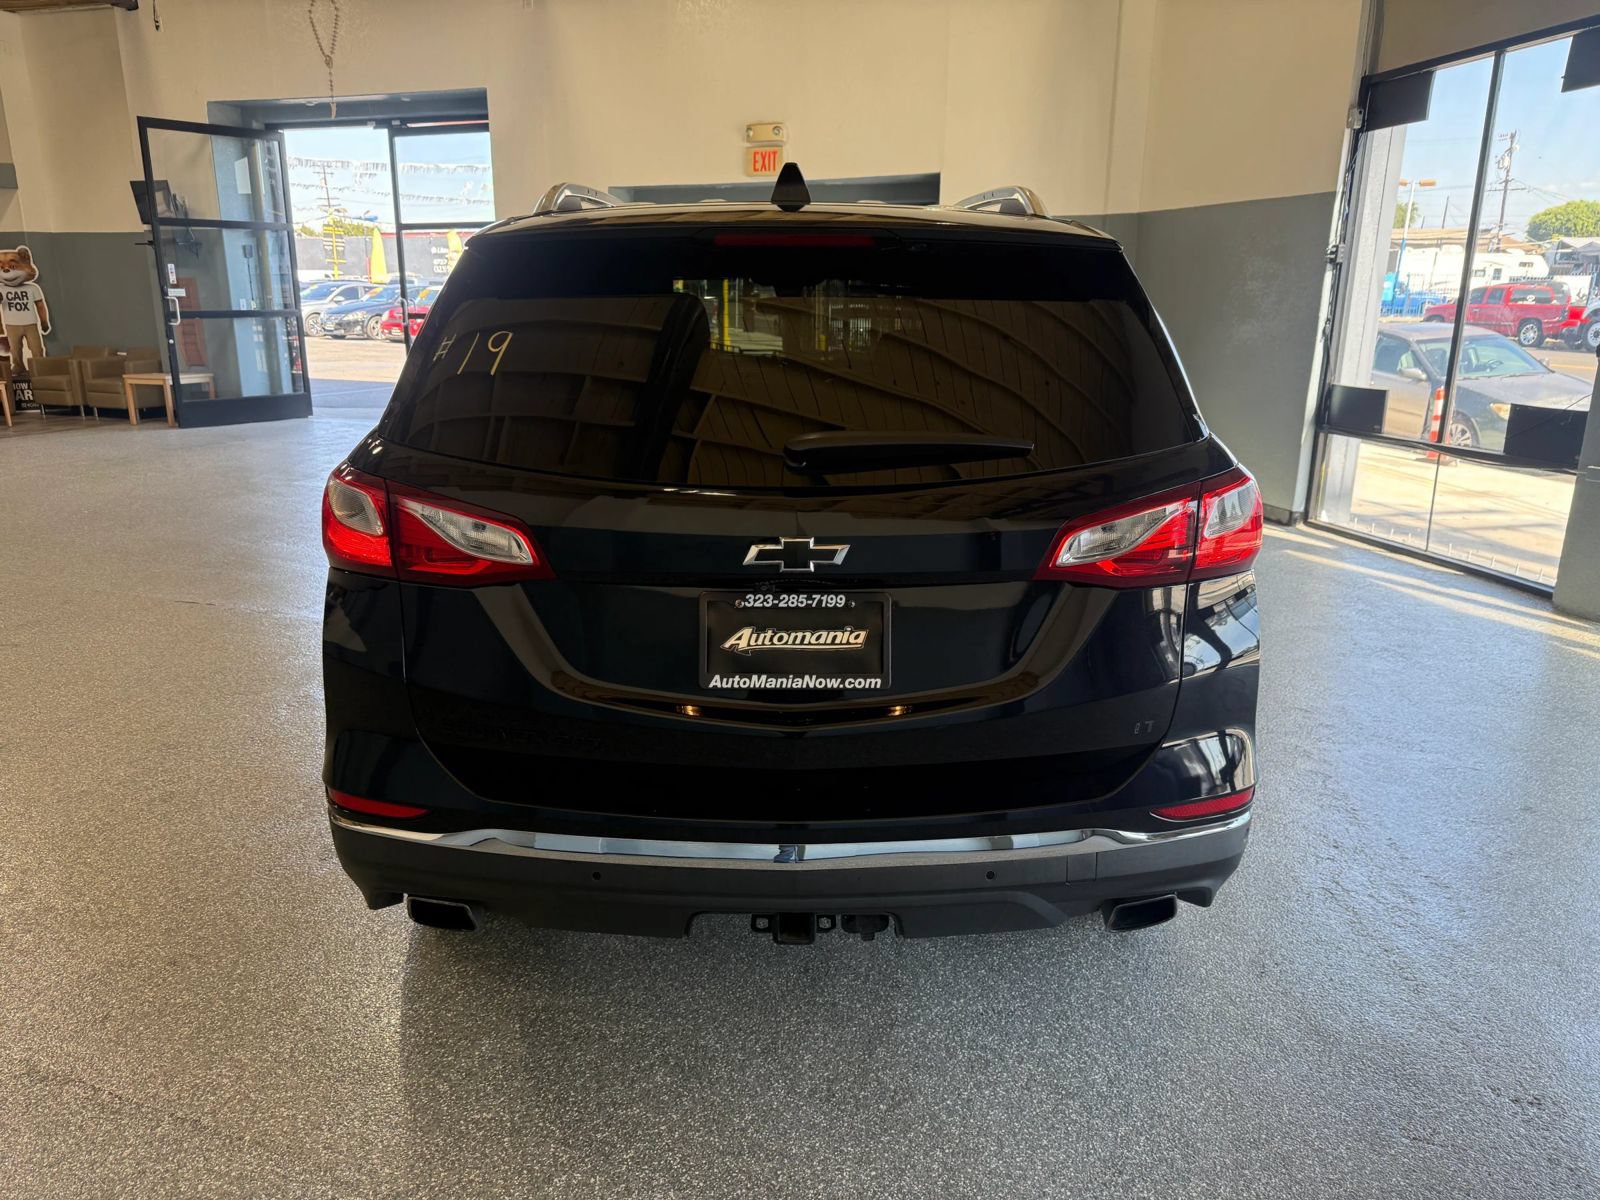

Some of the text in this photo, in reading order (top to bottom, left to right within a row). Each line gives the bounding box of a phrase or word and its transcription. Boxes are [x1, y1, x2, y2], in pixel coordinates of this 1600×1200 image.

[752, 150, 778, 173] EXIT
[6, 291, 29, 301] CAR
[8, 302, 30, 311] FOX
[744, 594, 846, 608] 323-285-7199
[720, 626, 868, 651] Automania
[708, 674, 882, 689] AutoManiaNow.com
